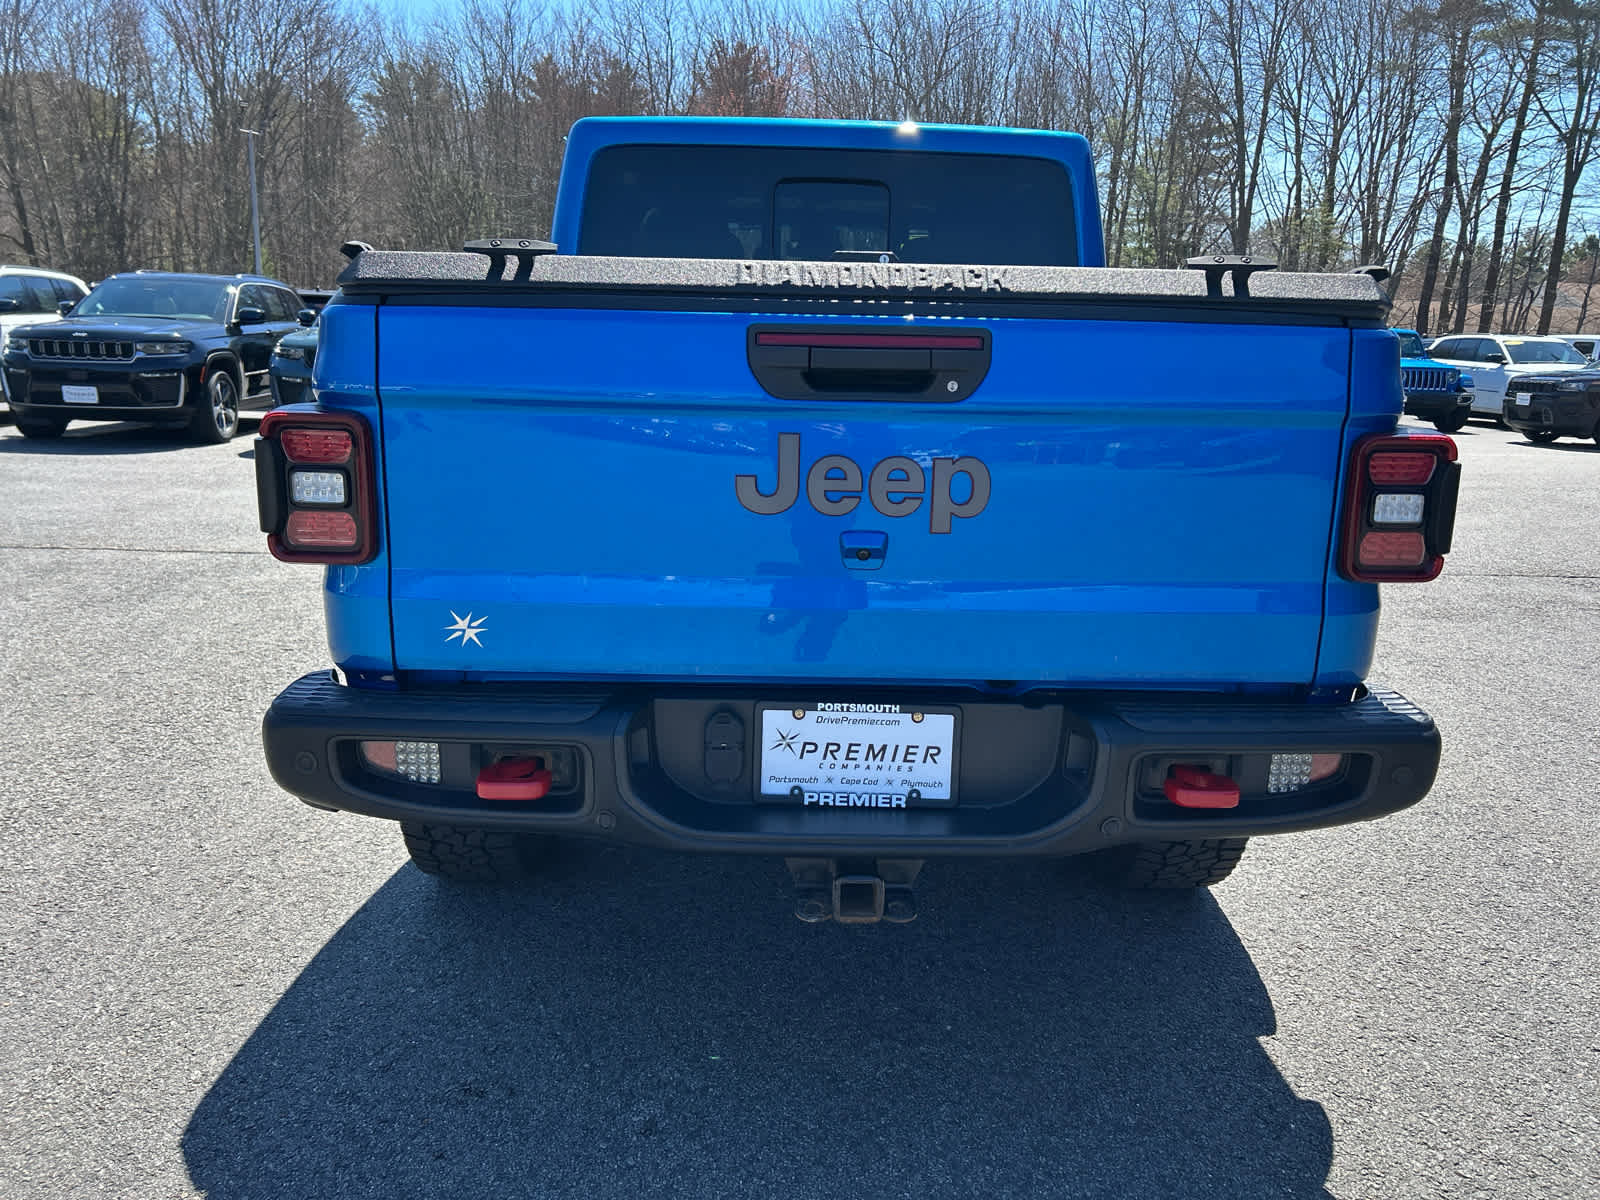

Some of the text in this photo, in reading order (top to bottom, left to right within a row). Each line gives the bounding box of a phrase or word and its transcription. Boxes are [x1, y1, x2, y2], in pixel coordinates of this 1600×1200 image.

[738, 260, 1009, 292] DIAMONDBACK
[735, 432, 992, 534] Jeep
[817, 702, 900, 713] PORTSMOUTH
[816, 716, 901, 727] DrivePremier.com
[799, 741, 942, 765] PREMIER
[819, 763, 914, 773] COMPANIES
[768, 775, 943, 789] Portsmouth Cape Cod Plymouth
[804, 792, 906, 808] PREMIER
